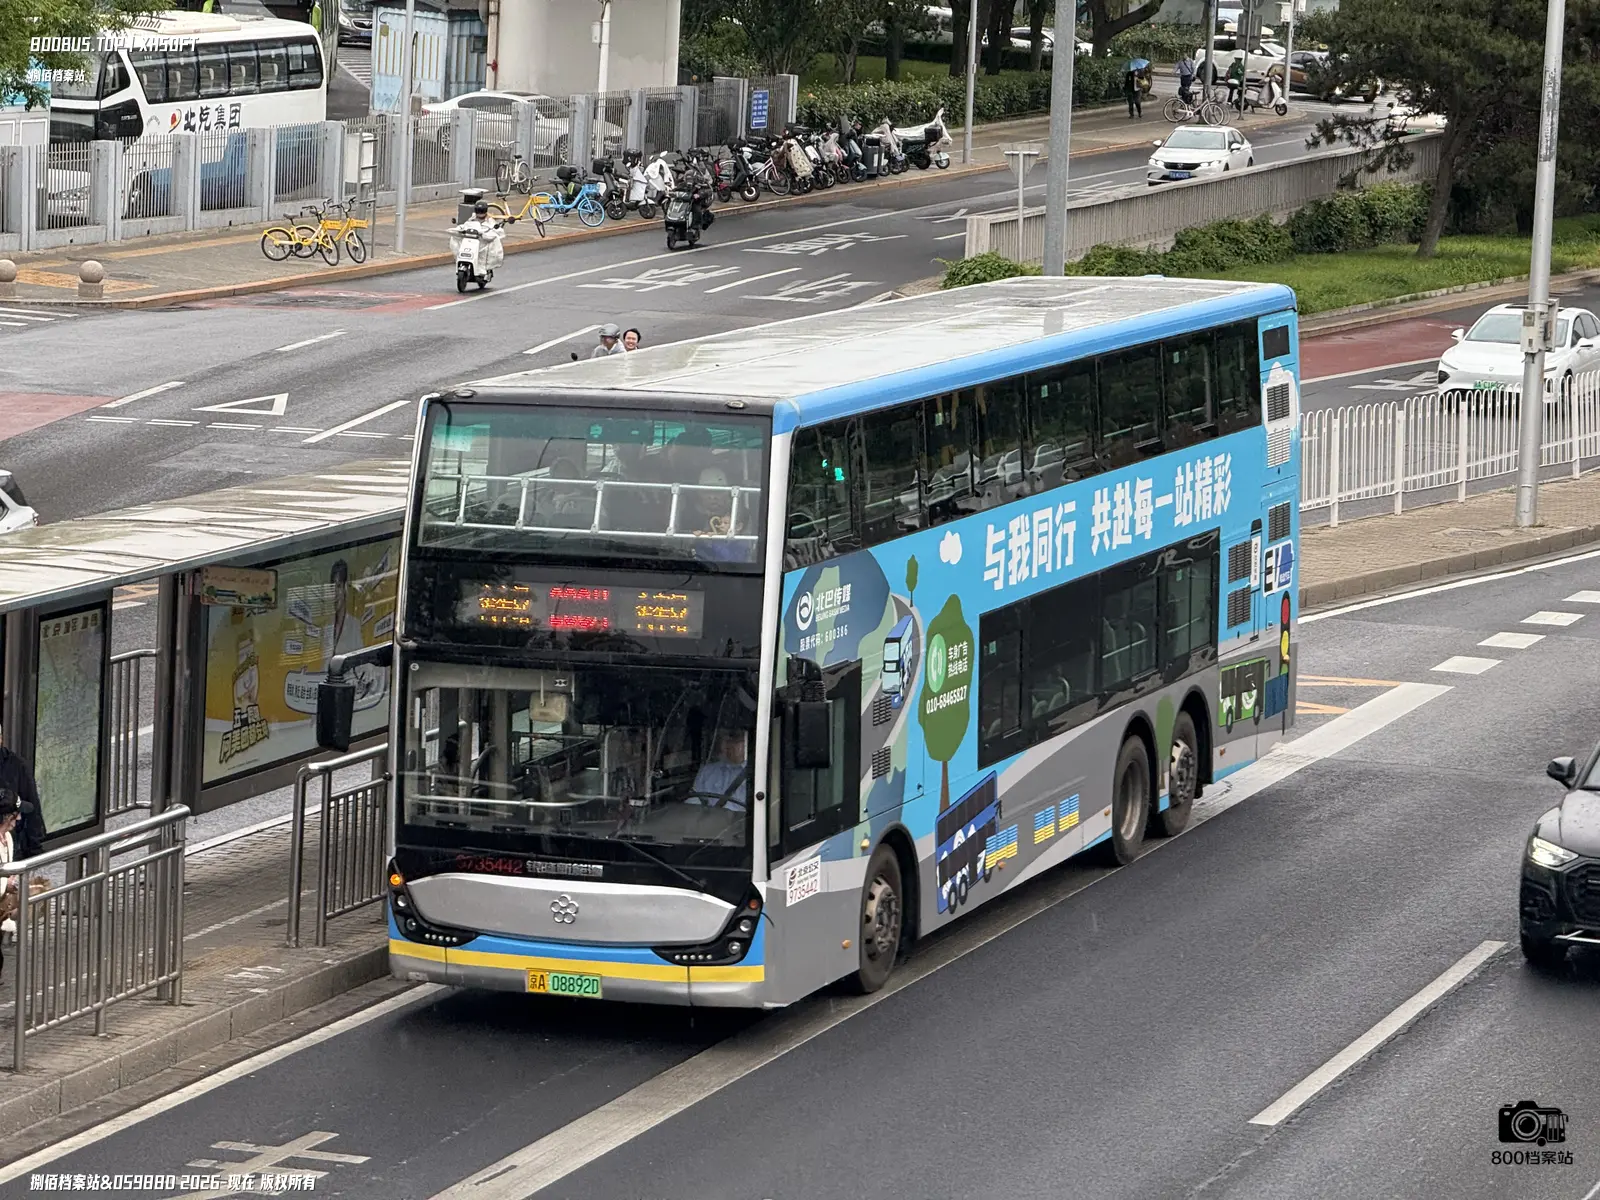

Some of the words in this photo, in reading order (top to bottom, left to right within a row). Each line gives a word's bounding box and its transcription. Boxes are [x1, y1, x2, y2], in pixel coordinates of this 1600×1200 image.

[983, 500, 1077, 591] 与我同行
[1091, 452, 1232, 556] 共赴每一站精彩
[815, 583, 852, 612] 北巴传媒
[947, 640, 968, 661] 车身广告
